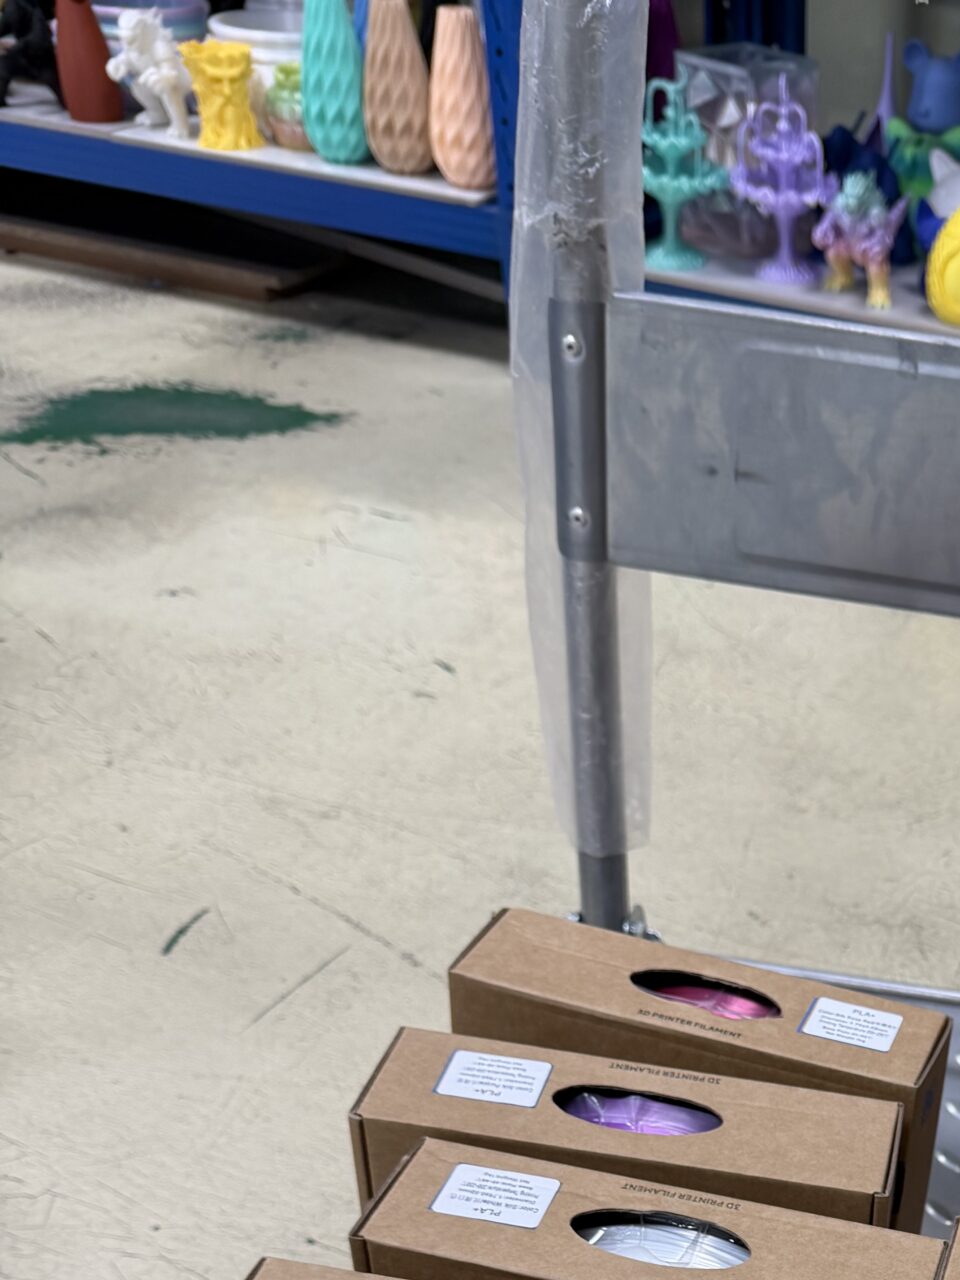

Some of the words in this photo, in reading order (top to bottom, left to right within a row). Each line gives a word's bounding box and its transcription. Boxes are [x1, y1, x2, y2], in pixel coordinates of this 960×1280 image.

[852, 1008, 876, 1018] PLA+
[637, 1008, 652, 1016] 3D
[651, 1011, 693, 1026] PRINTER
[693, 1021, 742, 1039] FILAMENT
[608, 1062, 661, 1076] FILAMENT
[662, 1070, 706, 1083] PRINTER
[707, 1077, 721, 1085] 3D
[620, 1183, 677, 1199] FILAMENT
[677, 1193, 725, 1208] PRINTER
[725, 1202, 742, 1211] 3D
[472, 1207, 502, 1217] PLA+
